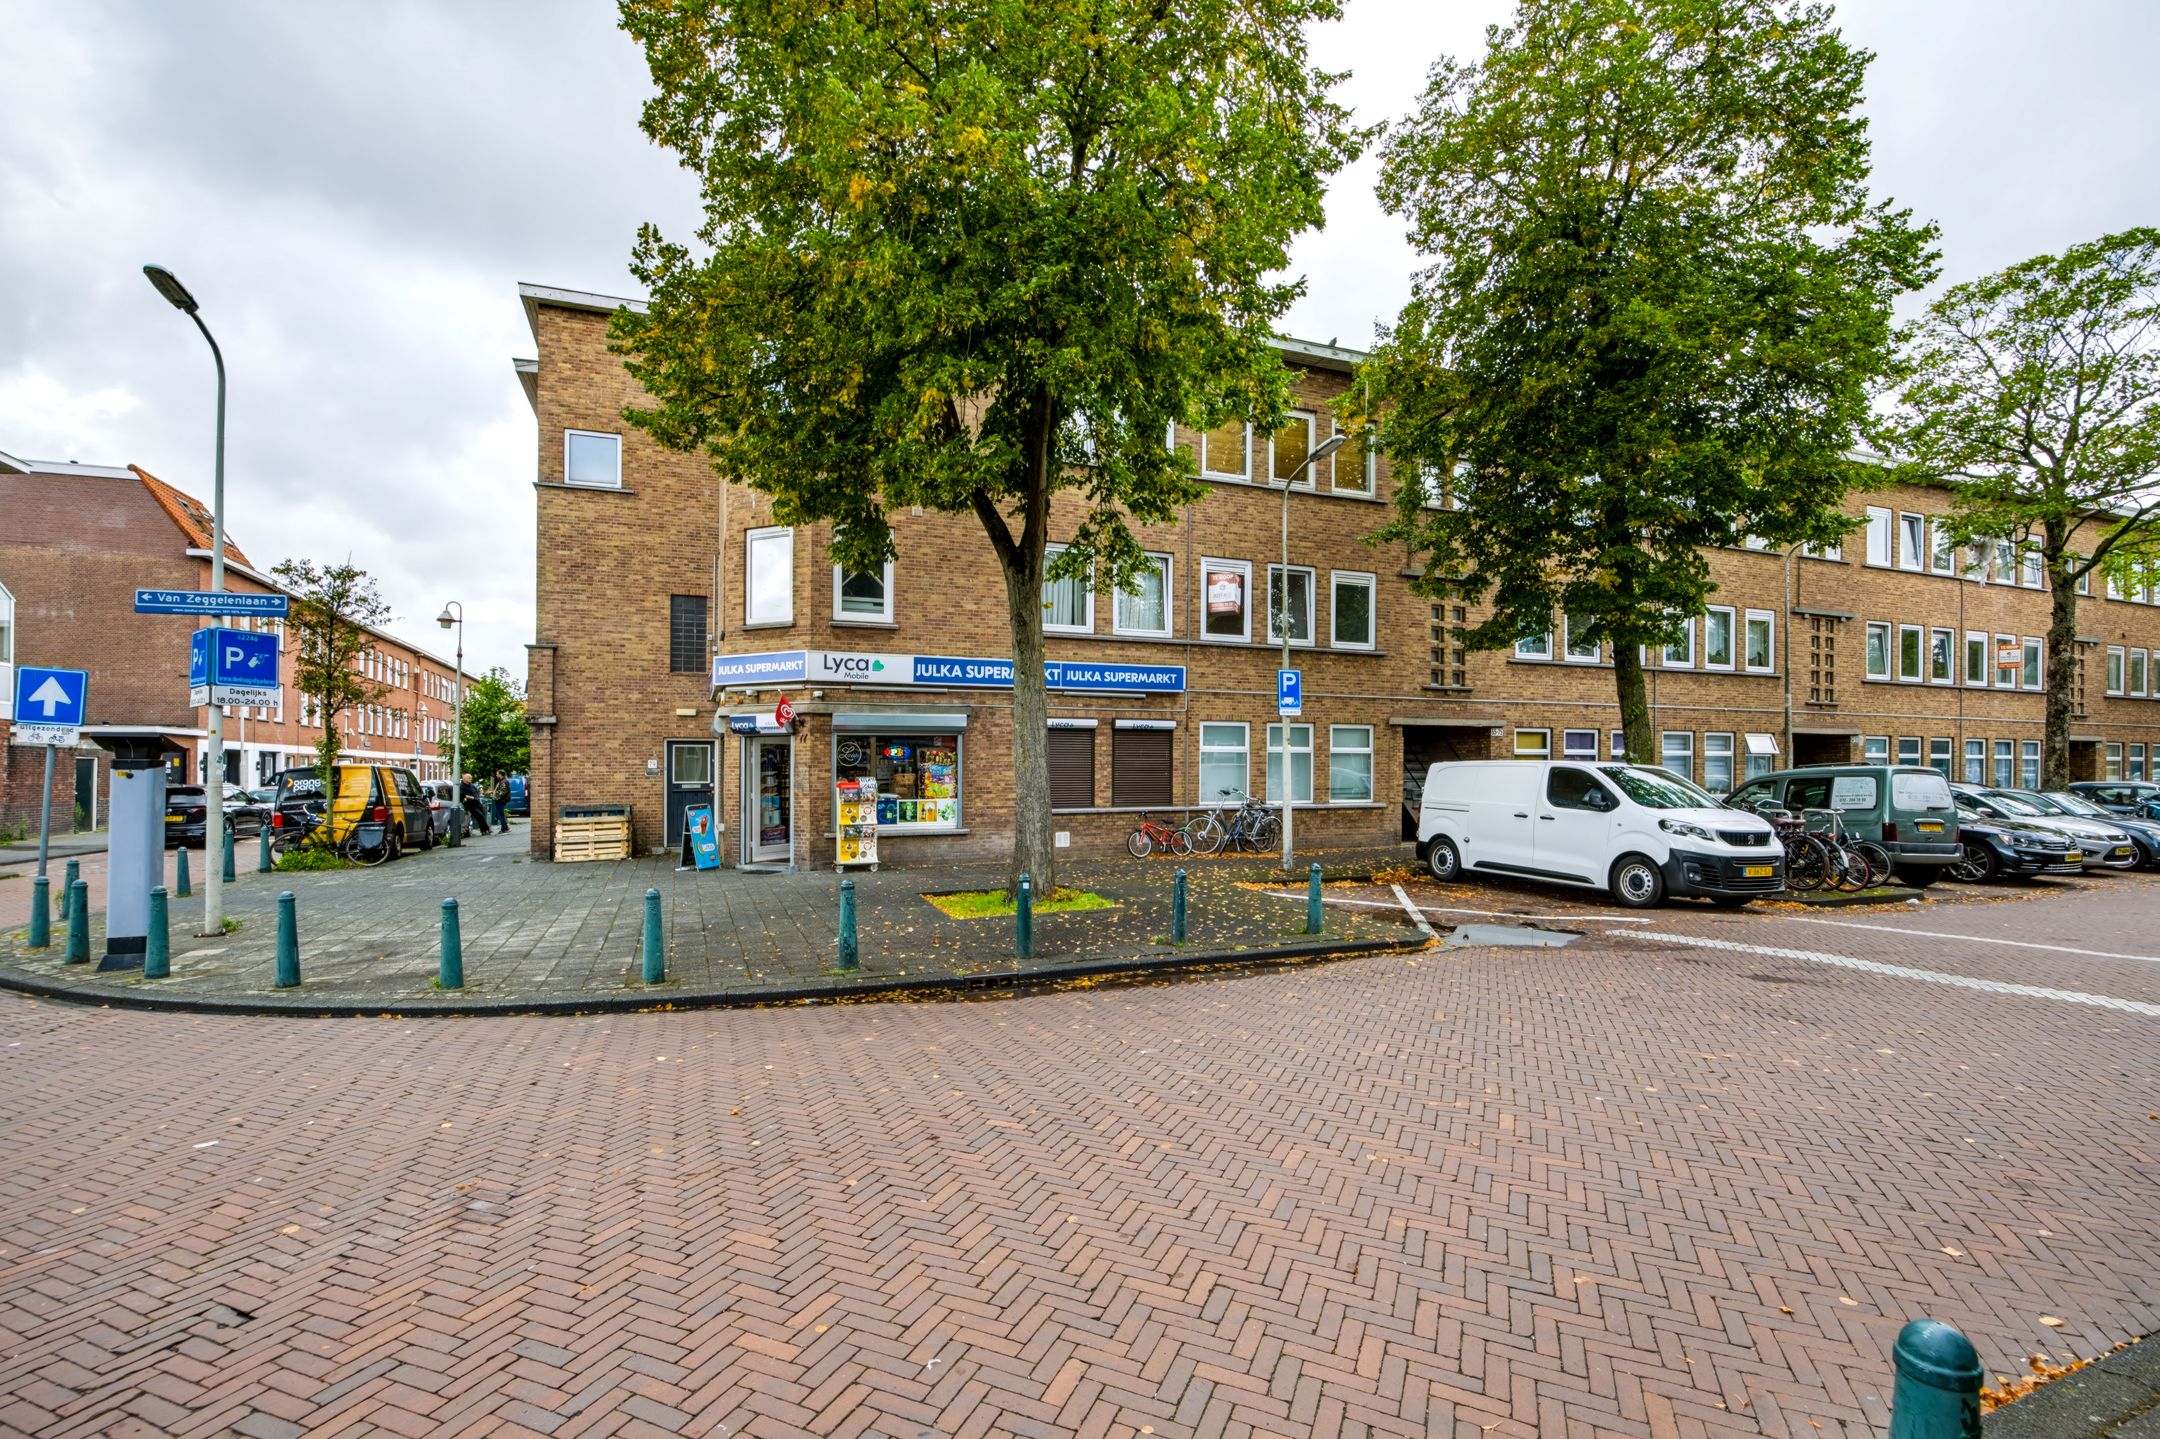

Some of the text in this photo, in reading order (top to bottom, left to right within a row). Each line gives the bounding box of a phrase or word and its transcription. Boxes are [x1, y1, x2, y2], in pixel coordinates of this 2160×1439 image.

[157, 592, 267, 606] Van Zeggelenlaan
[225, 646, 244, 669] P
[823, 653, 870, 674] Lyca
[718, 660, 804, 675] JULKA SUPERMARKT
[915, 663, 1060, 681] JULKA SUPERKT
[844, 672, 869, 680] Mobile
[1066, 670, 1177, 684] JULKA SUPERMARKT
[1282, 672, 1297, 692] P
[229, 688, 267, 697] Dagelijks
[217, 697, 271, 706] 18.00-24.00
[731, 721, 749, 730] Lyca
[1051, 720, 1069, 728] Lyca
[293, 784, 316, 793] parq
